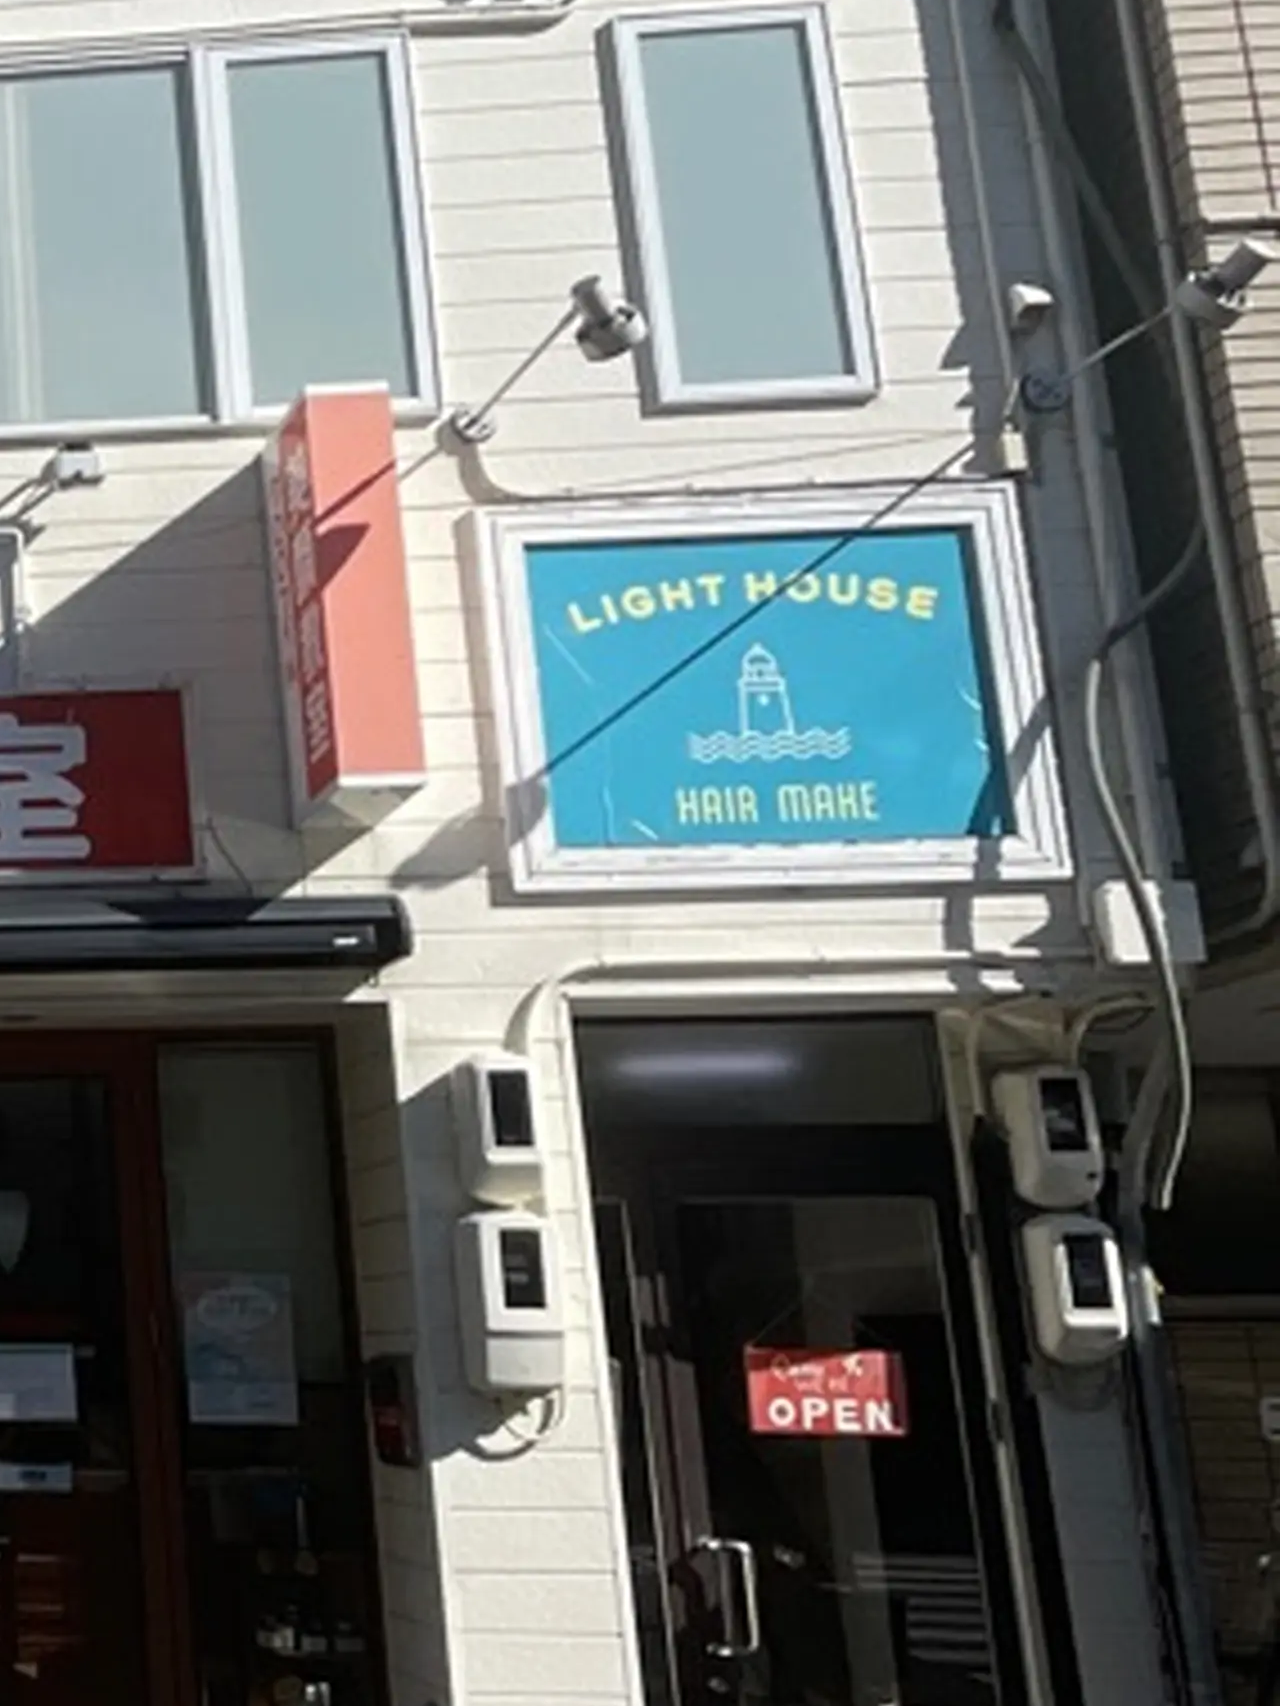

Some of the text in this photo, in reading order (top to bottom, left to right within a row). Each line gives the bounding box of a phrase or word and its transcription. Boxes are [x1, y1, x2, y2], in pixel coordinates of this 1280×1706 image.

[566, 570, 939, 636] LIGHT HOUSE
[674, 781, 881, 826] HAIR MAKE
[767, 1397, 894, 1432] OPEN
